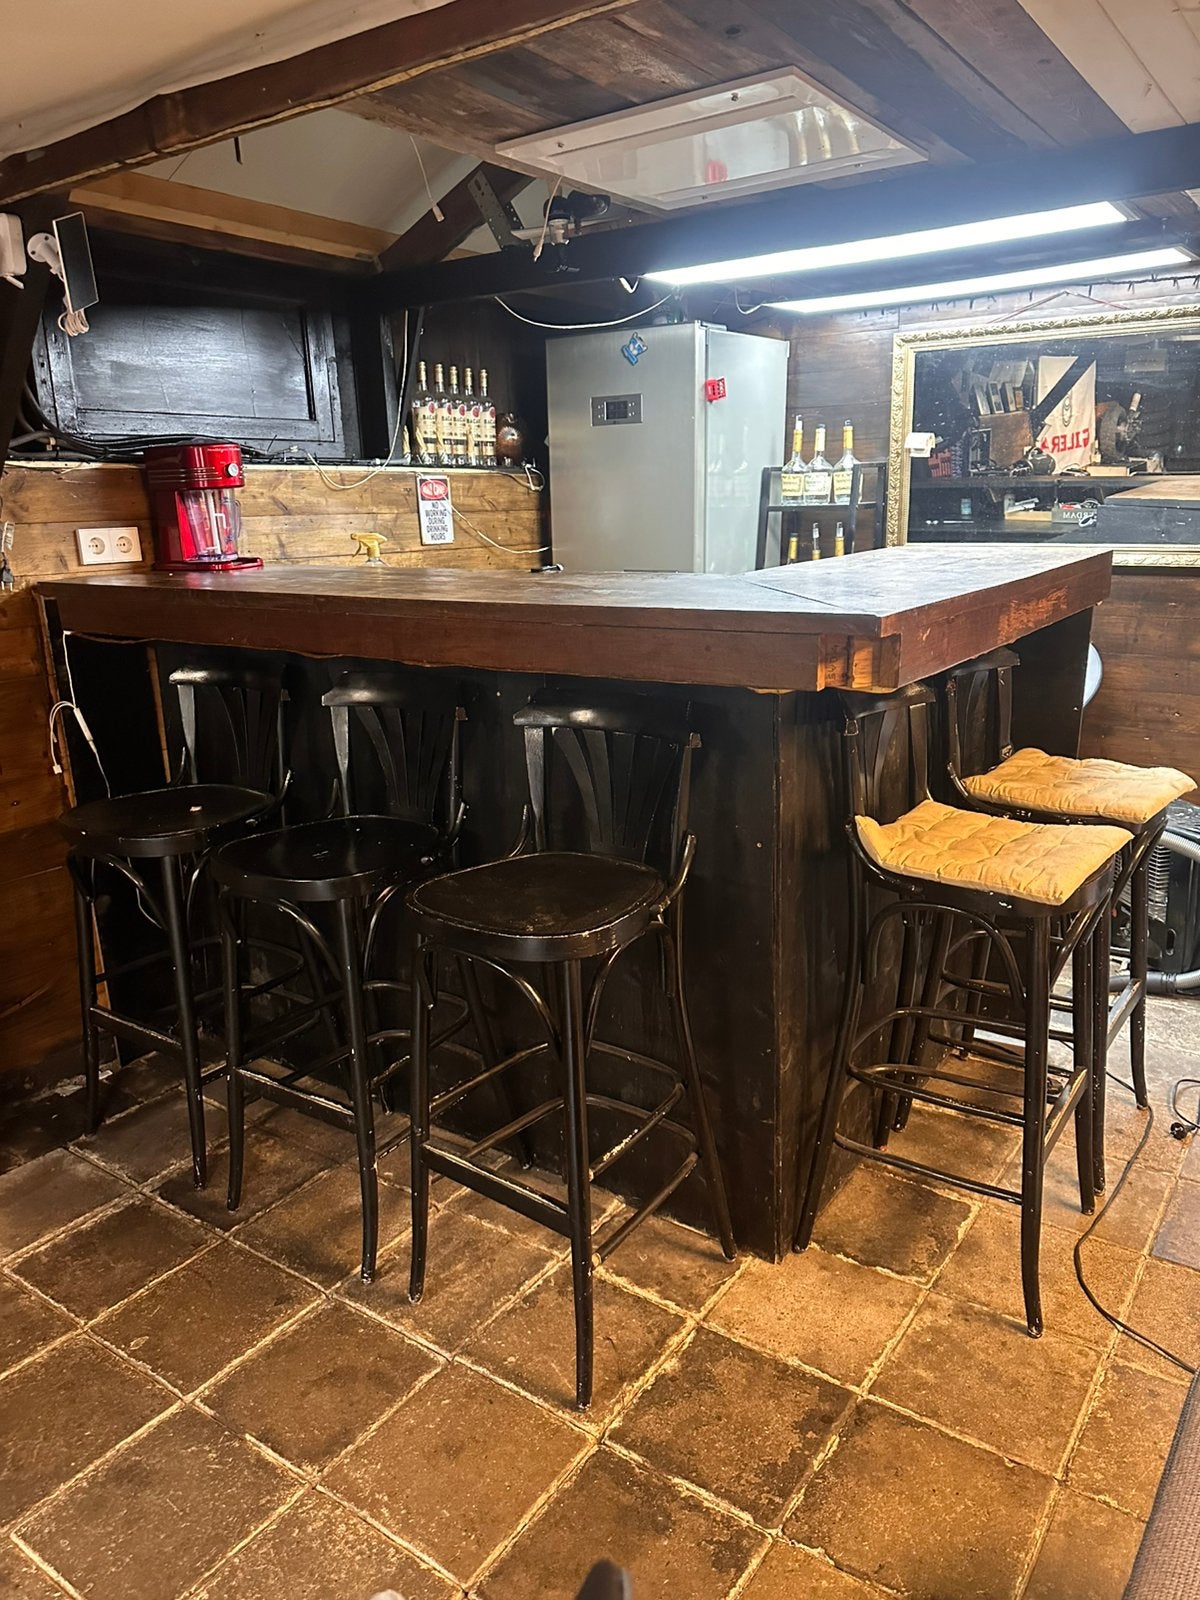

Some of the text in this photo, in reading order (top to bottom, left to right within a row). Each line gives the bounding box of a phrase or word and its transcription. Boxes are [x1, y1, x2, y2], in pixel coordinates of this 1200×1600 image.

[431, 501, 439, 509] NO
[425, 508, 447, 517] WORKING
[428, 516, 446, 525] DURING
[427, 524, 449, 533] DRINKING
[430, 532, 446, 541] HOURS
